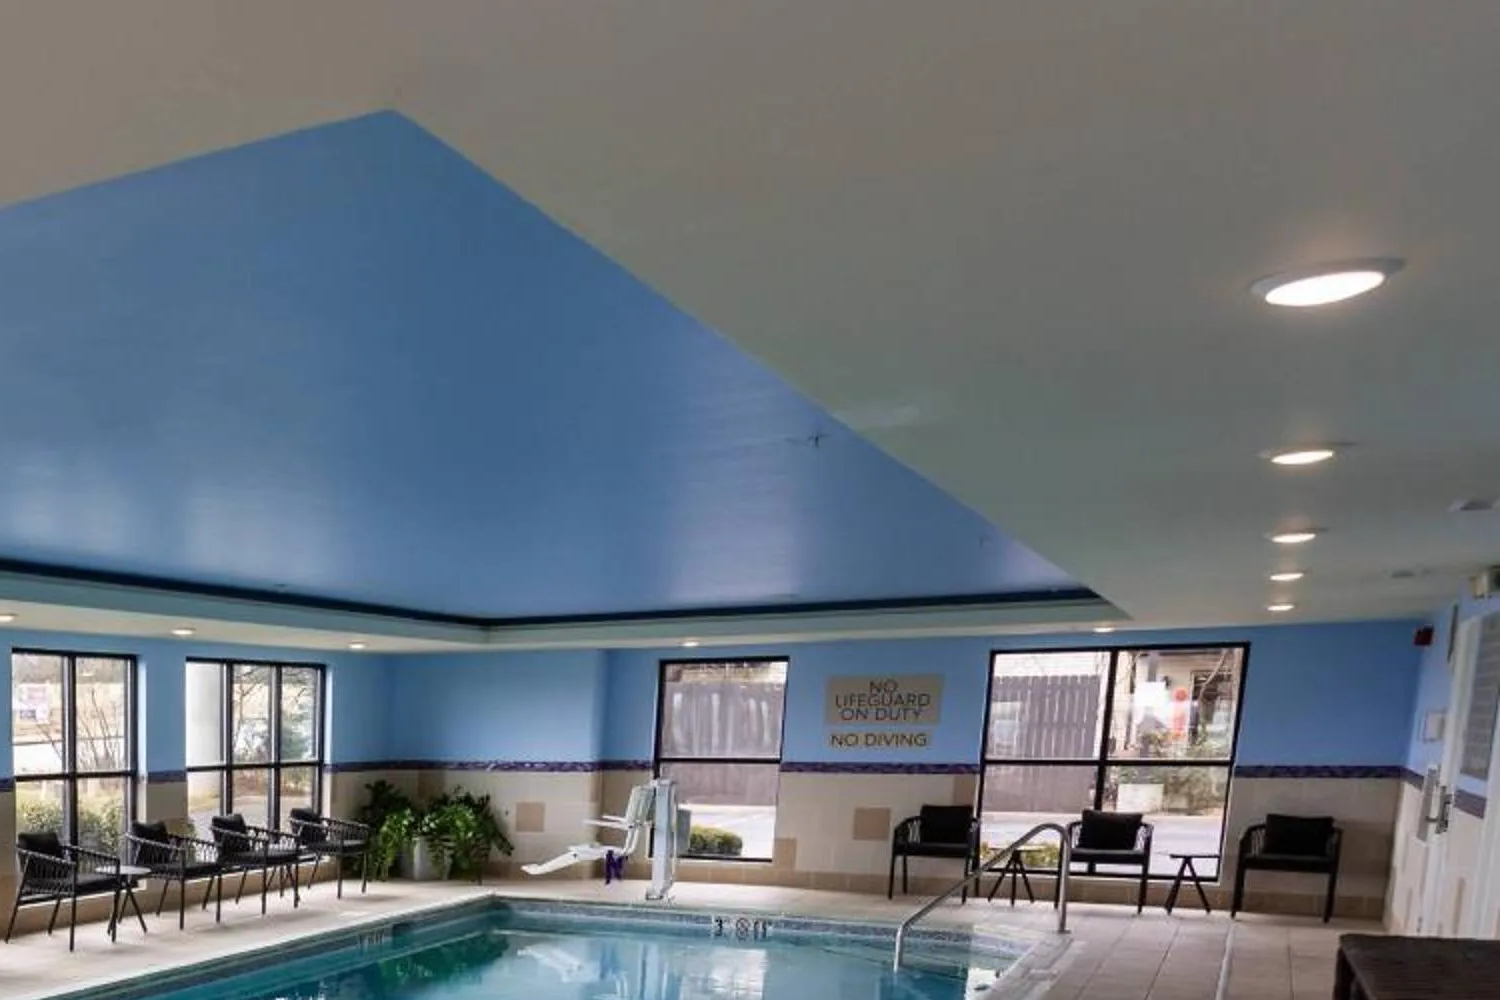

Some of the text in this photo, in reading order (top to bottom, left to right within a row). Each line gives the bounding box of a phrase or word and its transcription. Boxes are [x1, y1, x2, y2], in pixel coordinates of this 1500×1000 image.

[869, 679, 898, 693] NO
[835, 693, 931, 707] LIFEGUARD
[841, 708, 924, 721] ON DUTY
[831, 733, 927, 747] NO DIVING
